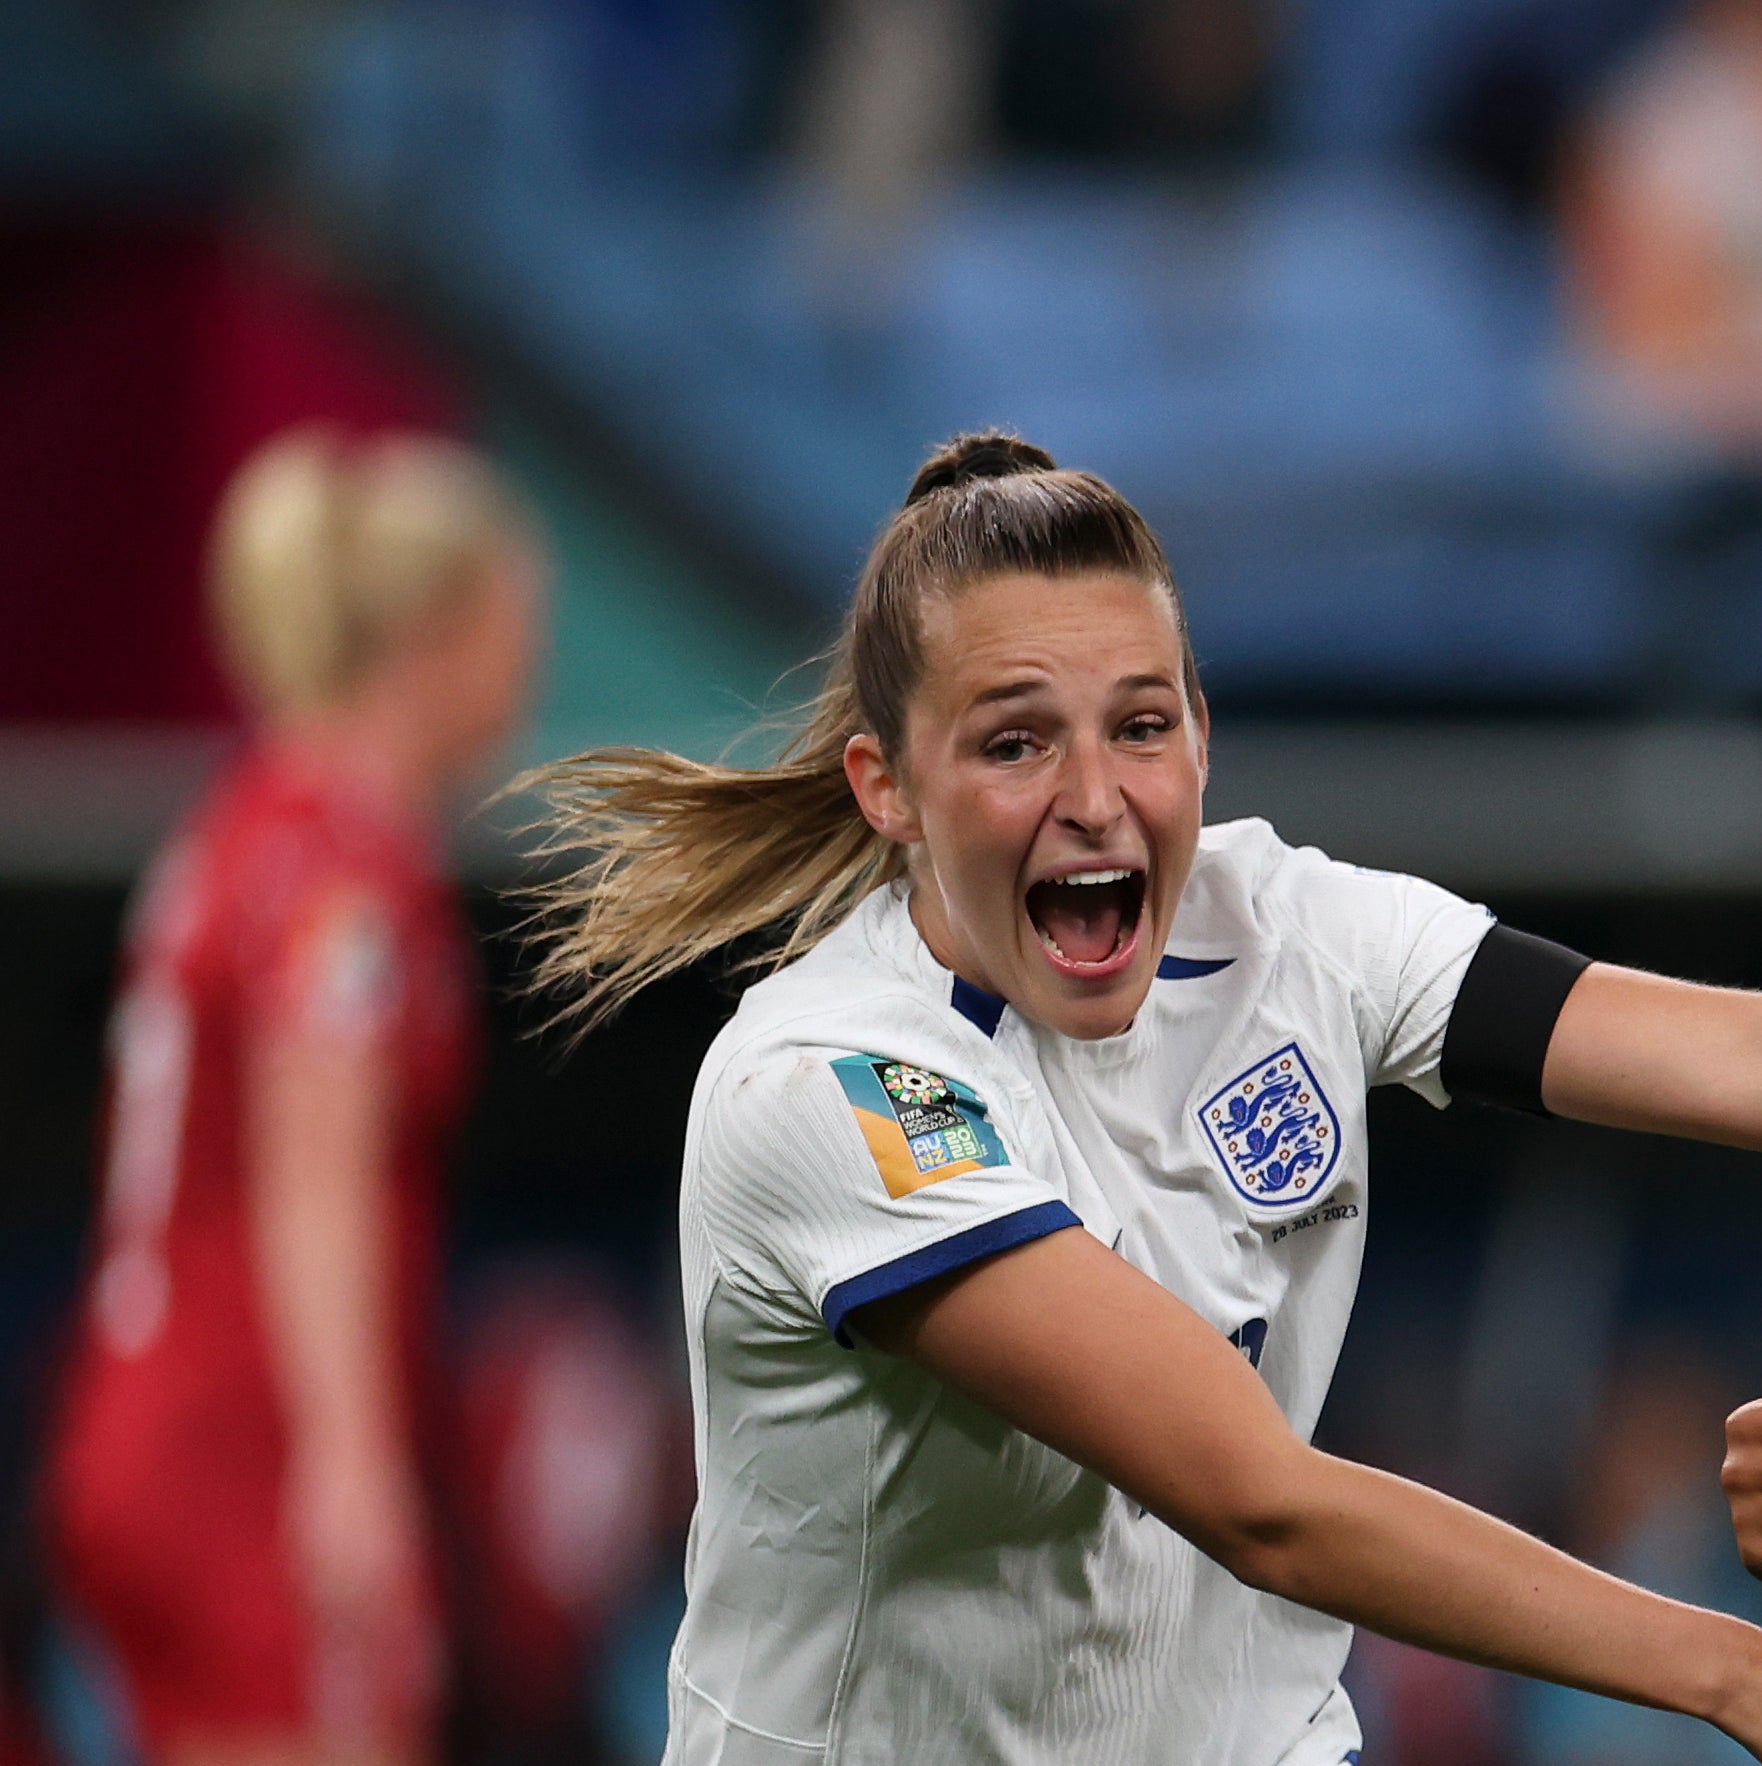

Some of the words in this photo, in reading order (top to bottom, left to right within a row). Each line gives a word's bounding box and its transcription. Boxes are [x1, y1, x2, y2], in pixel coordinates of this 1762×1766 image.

[900, 1108, 924, 1122] FIFA
[903, 1111, 946, 1130] WOMEN'S
[906, 1121, 938, 1137] WORLD
[938, 1116, 956, 1128] CUP
[944, 1127, 971, 1144] 20
[913, 1134, 942, 1156] AU
[949, 1141, 977, 1160] 23
[918, 1148, 948, 1169] NZ
[1292, 1213, 1318, 1233] JULY
[1322, 1204, 1359, 1221] 2023
